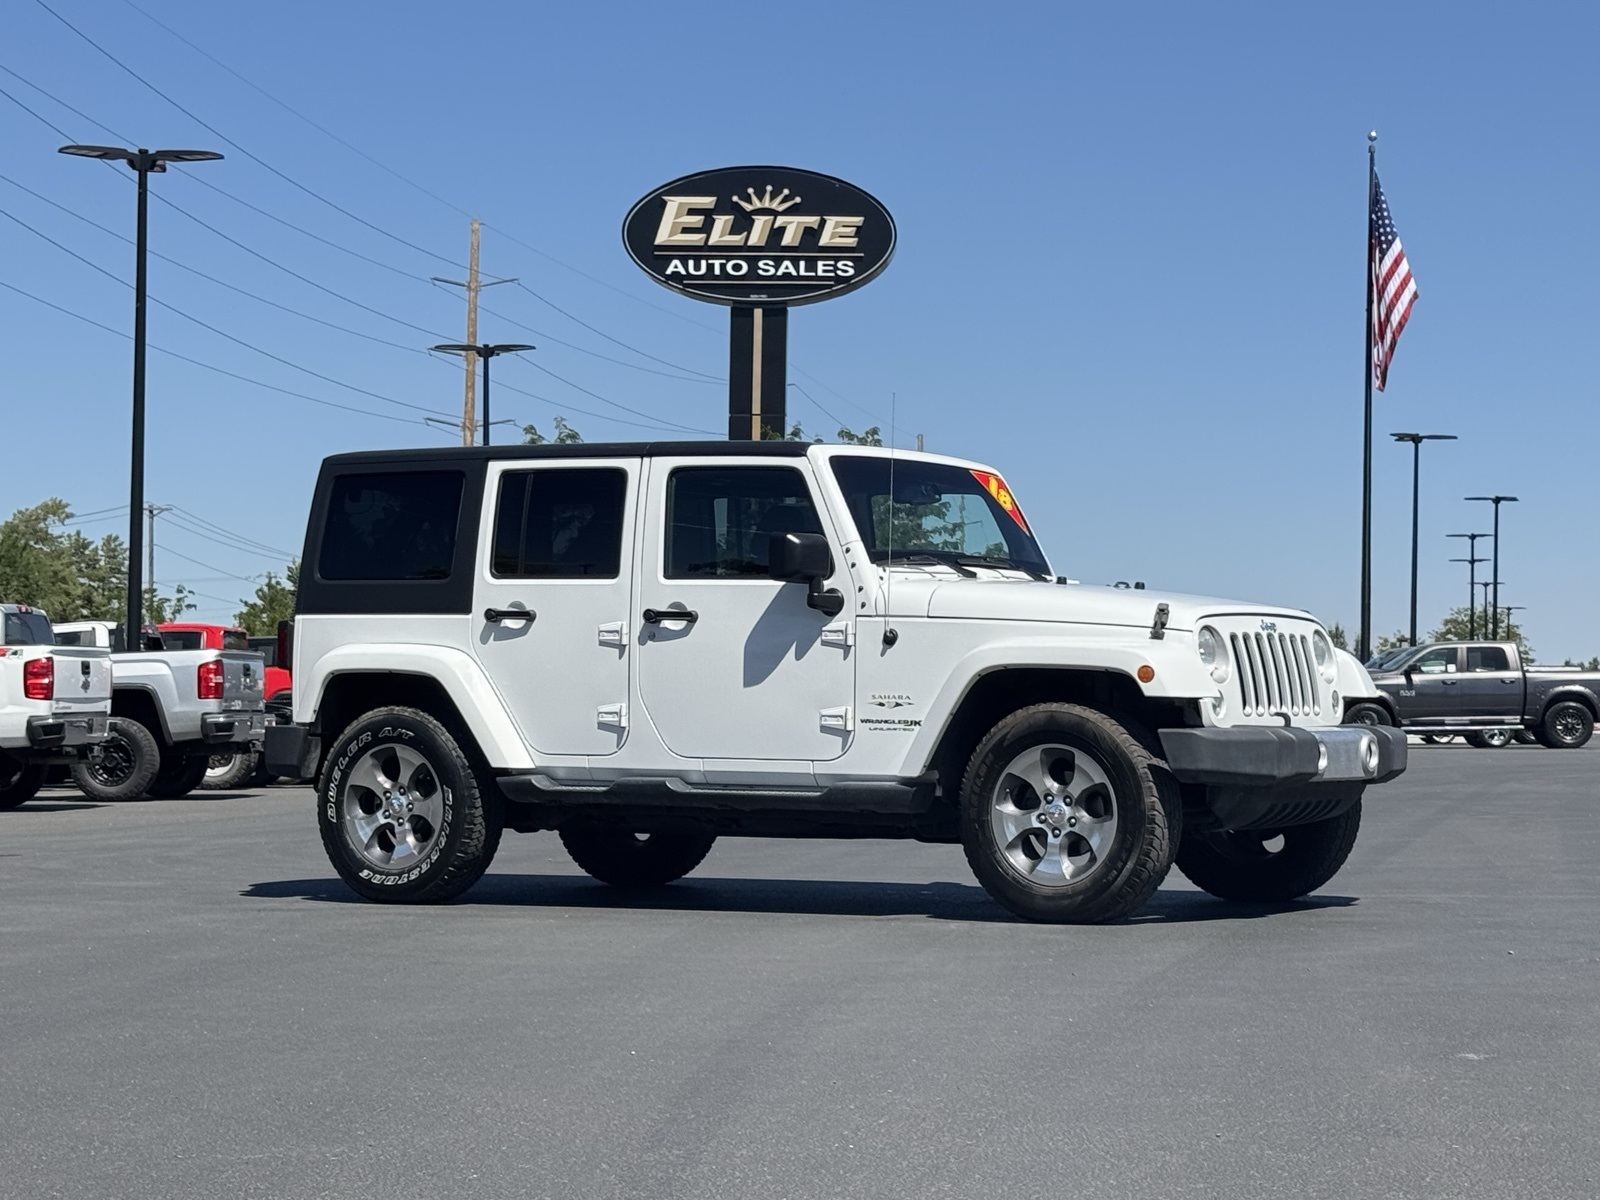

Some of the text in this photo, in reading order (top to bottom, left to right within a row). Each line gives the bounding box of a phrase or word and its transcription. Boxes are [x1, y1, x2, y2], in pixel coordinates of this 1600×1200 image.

[665, 259, 855, 276] AUTO SALES
[378, 727, 415, 739] A/T
